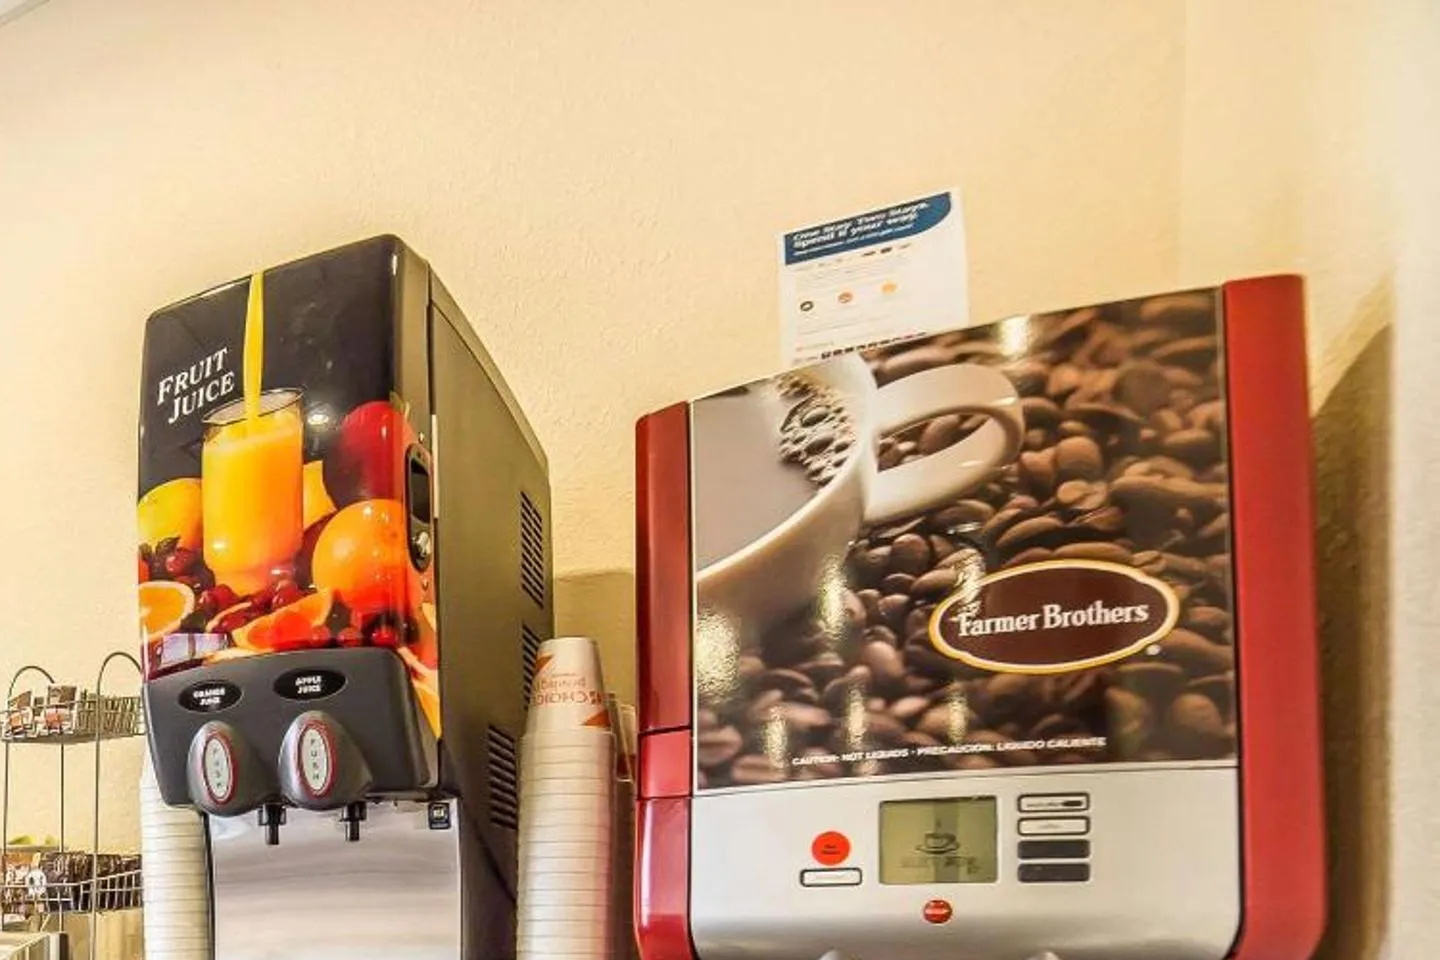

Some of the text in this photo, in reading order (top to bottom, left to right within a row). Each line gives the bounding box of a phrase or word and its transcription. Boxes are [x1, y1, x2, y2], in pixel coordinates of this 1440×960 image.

[157, 347, 228, 406] FRUIT
[168, 371, 235, 424] JUICE
[954, 600, 1150, 637] Farmer Brothers
